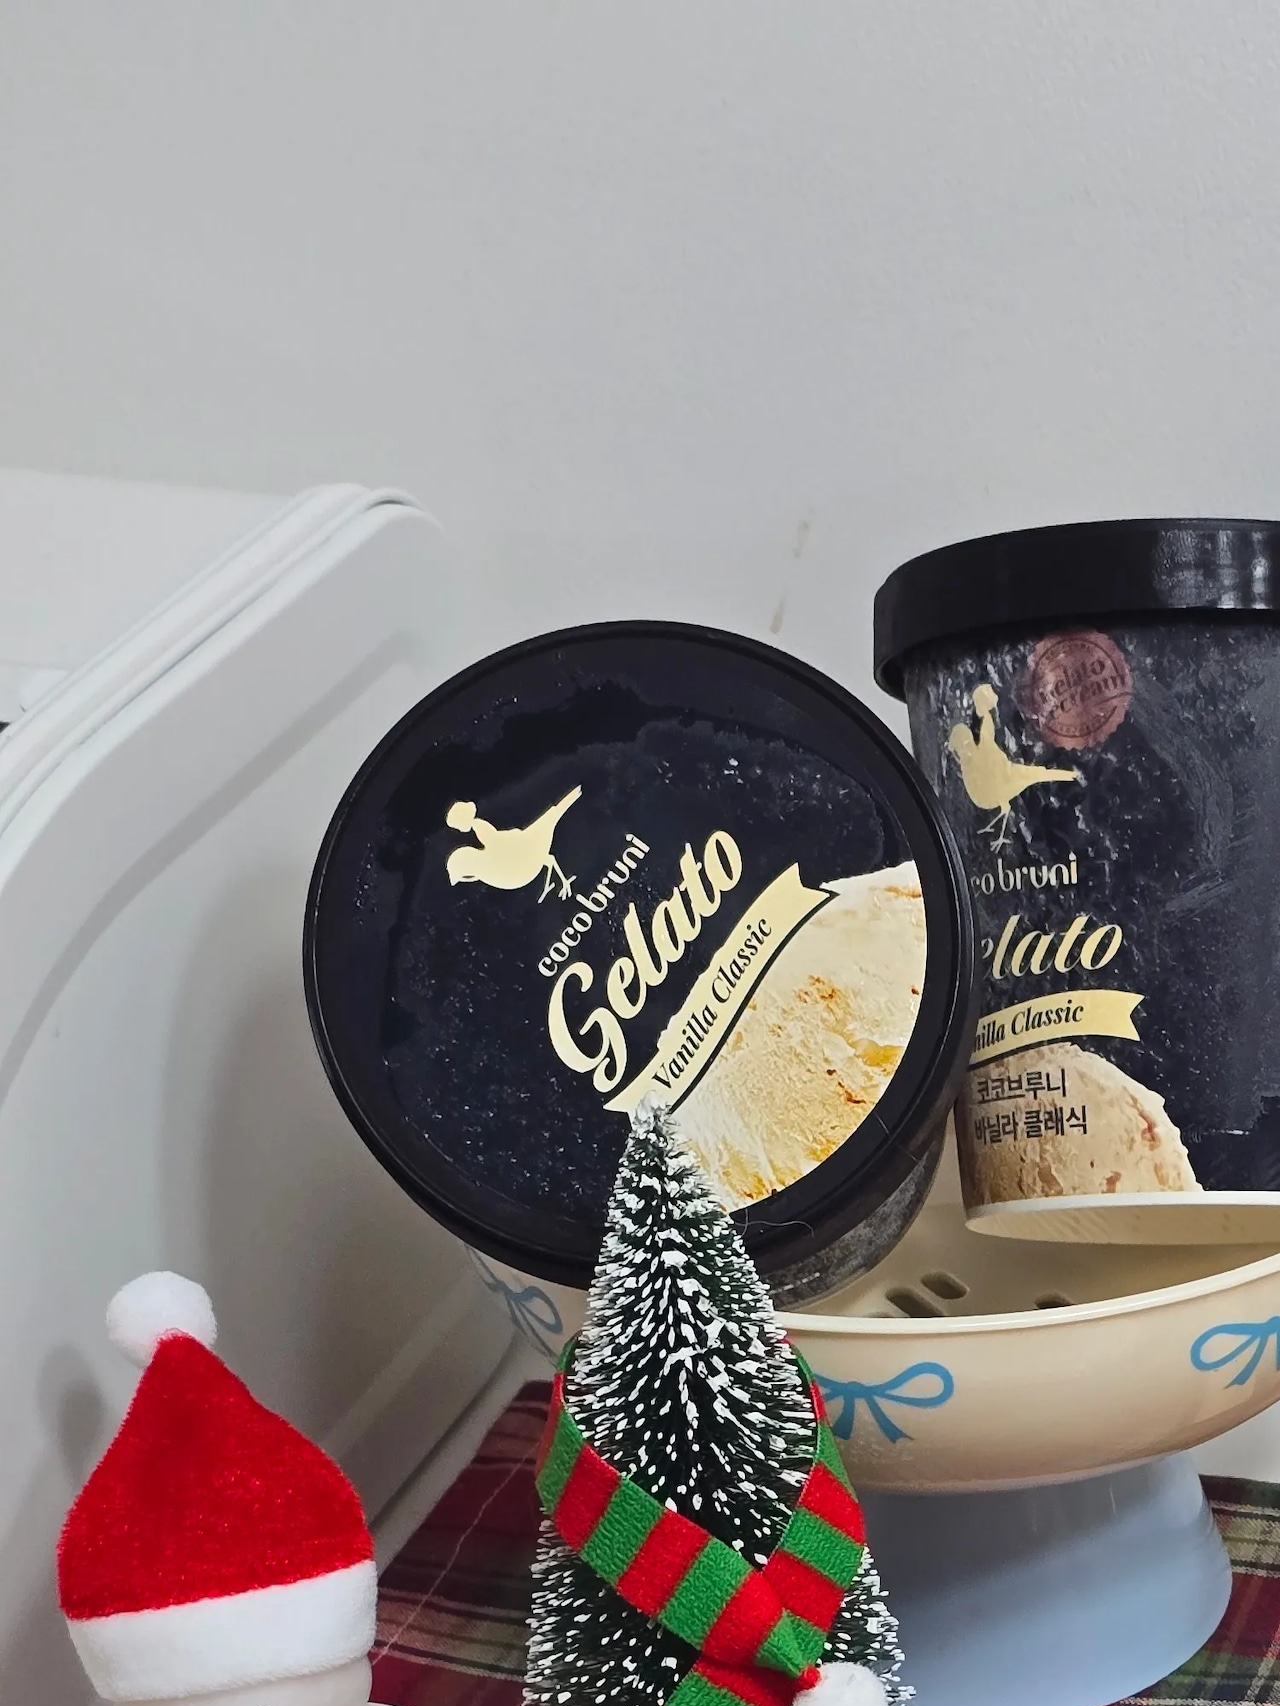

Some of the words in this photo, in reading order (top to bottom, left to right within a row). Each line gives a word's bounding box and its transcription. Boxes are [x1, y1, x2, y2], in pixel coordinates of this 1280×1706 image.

[548, 830, 743, 1092] Gelato
[651, 1006, 718, 1091] Vanilla
[711, 918, 773, 1004] Classic
[1011, 999, 1084, 1036] Classic
[977, 1068, 1066, 1104] 코코브루니
[974, 1111, 1019, 1145] 바닐라
[1024, 1105, 1087, 1138] 클래식
